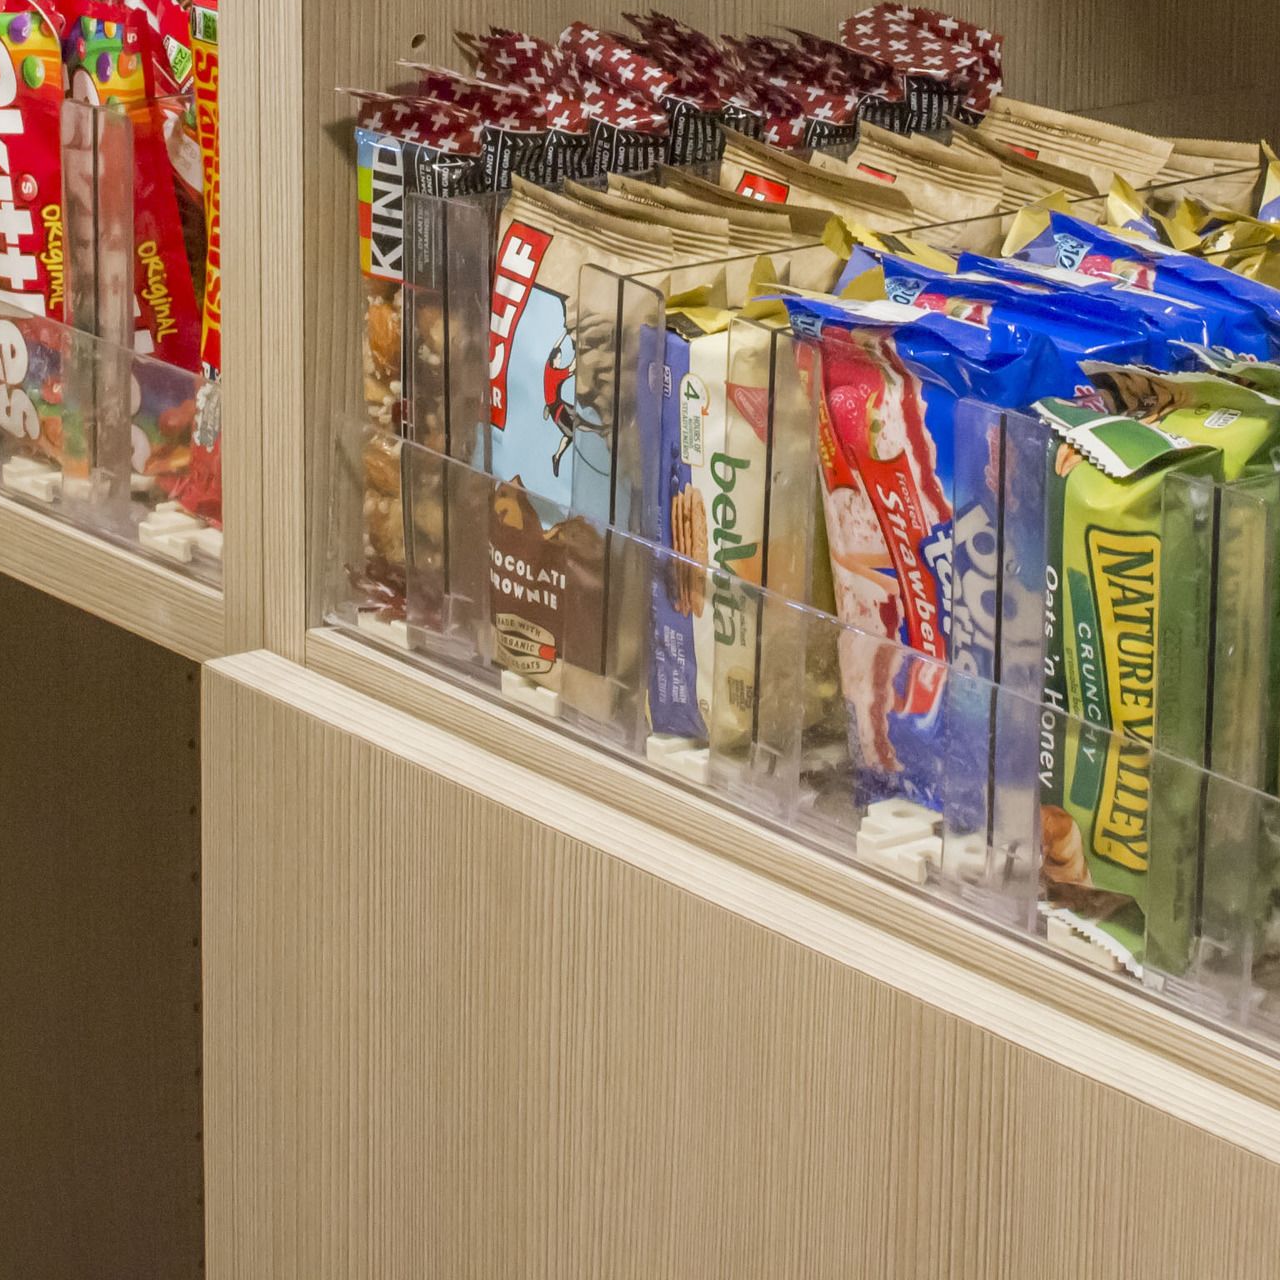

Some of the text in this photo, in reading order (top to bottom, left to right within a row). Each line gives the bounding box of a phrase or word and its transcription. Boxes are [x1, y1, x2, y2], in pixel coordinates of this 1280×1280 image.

[677, 116, 686, 135] GMO
[486, 155, 494, 176] AND
[500, 148, 511, 187] NON GMO
[546, 146, 554, 165] GMO
[600, 149, 609, 171] AND
[618, 146, 626, 166] GMO
[441, 167, 449, 187] GMO
[372, 136, 403, 280] KIND
[489, 235, 536, 380] CLIF
[684, 381, 700, 401] 4
[693, 415, 701, 444] HOURS
[895, 471, 921, 531] Frosted
[489, 545, 566, 589] OCOLAT
[710, 452, 758, 646] belVita
[876, 482, 937, 690] Strawbery
[1044, 565, 1059, 639] Oats
[500, 635, 535, 651] ORGANIC
[520, 622, 541, 638] WITH
[1077, 622, 1102, 764] CRUNCHY
[1097, 543, 1154, 865] NATURE VALLEY
[1038, 687, 1065, 789] Honey
